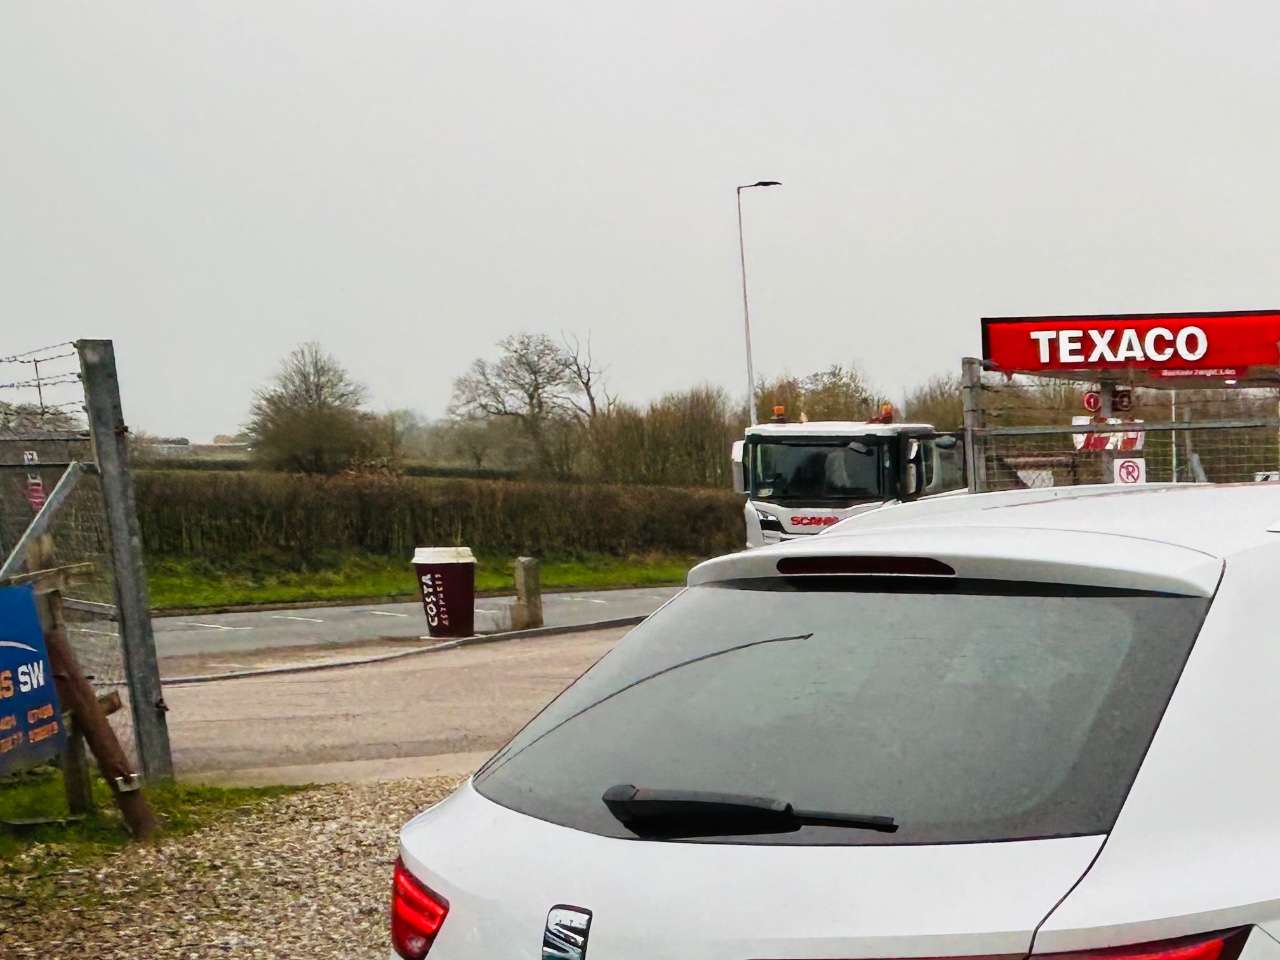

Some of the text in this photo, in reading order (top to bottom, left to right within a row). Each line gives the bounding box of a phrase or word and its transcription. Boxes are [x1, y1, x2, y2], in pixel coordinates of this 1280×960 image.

[1030, 325, 1208, 363] TEXACO
[421, 573, 438, 626] COSTA
[18, 660, 45, 693] SW
